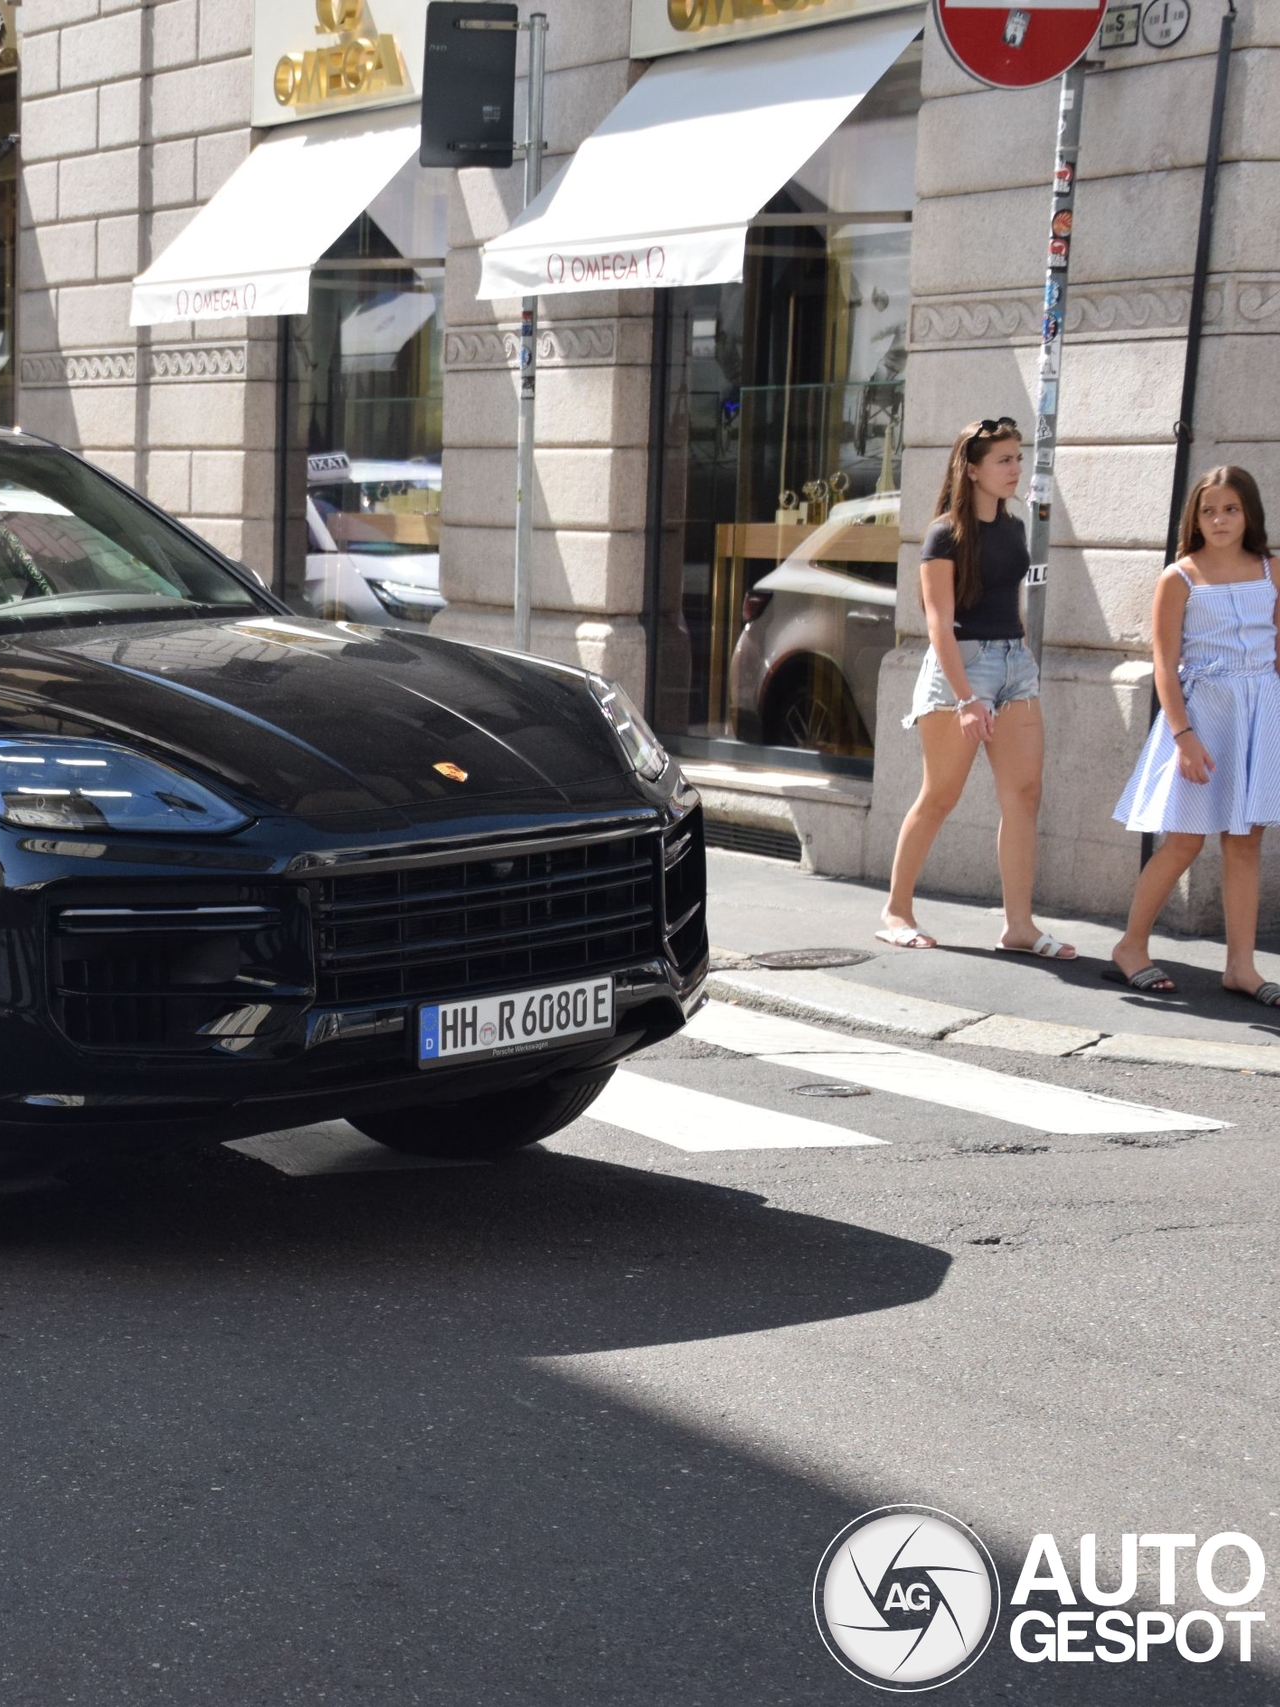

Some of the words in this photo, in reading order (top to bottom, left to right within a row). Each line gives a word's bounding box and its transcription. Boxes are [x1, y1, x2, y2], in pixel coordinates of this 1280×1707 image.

[274, 34, 404, 106] OMEGA
[571, 253, 639, 283] OMEGA
[192, 289, 239, 314] OMEGA
[425, 1037, 434, 1051] D
[441, 1005, 478, 1051] HH
[492, 1046, 515, 1057] Porsche
